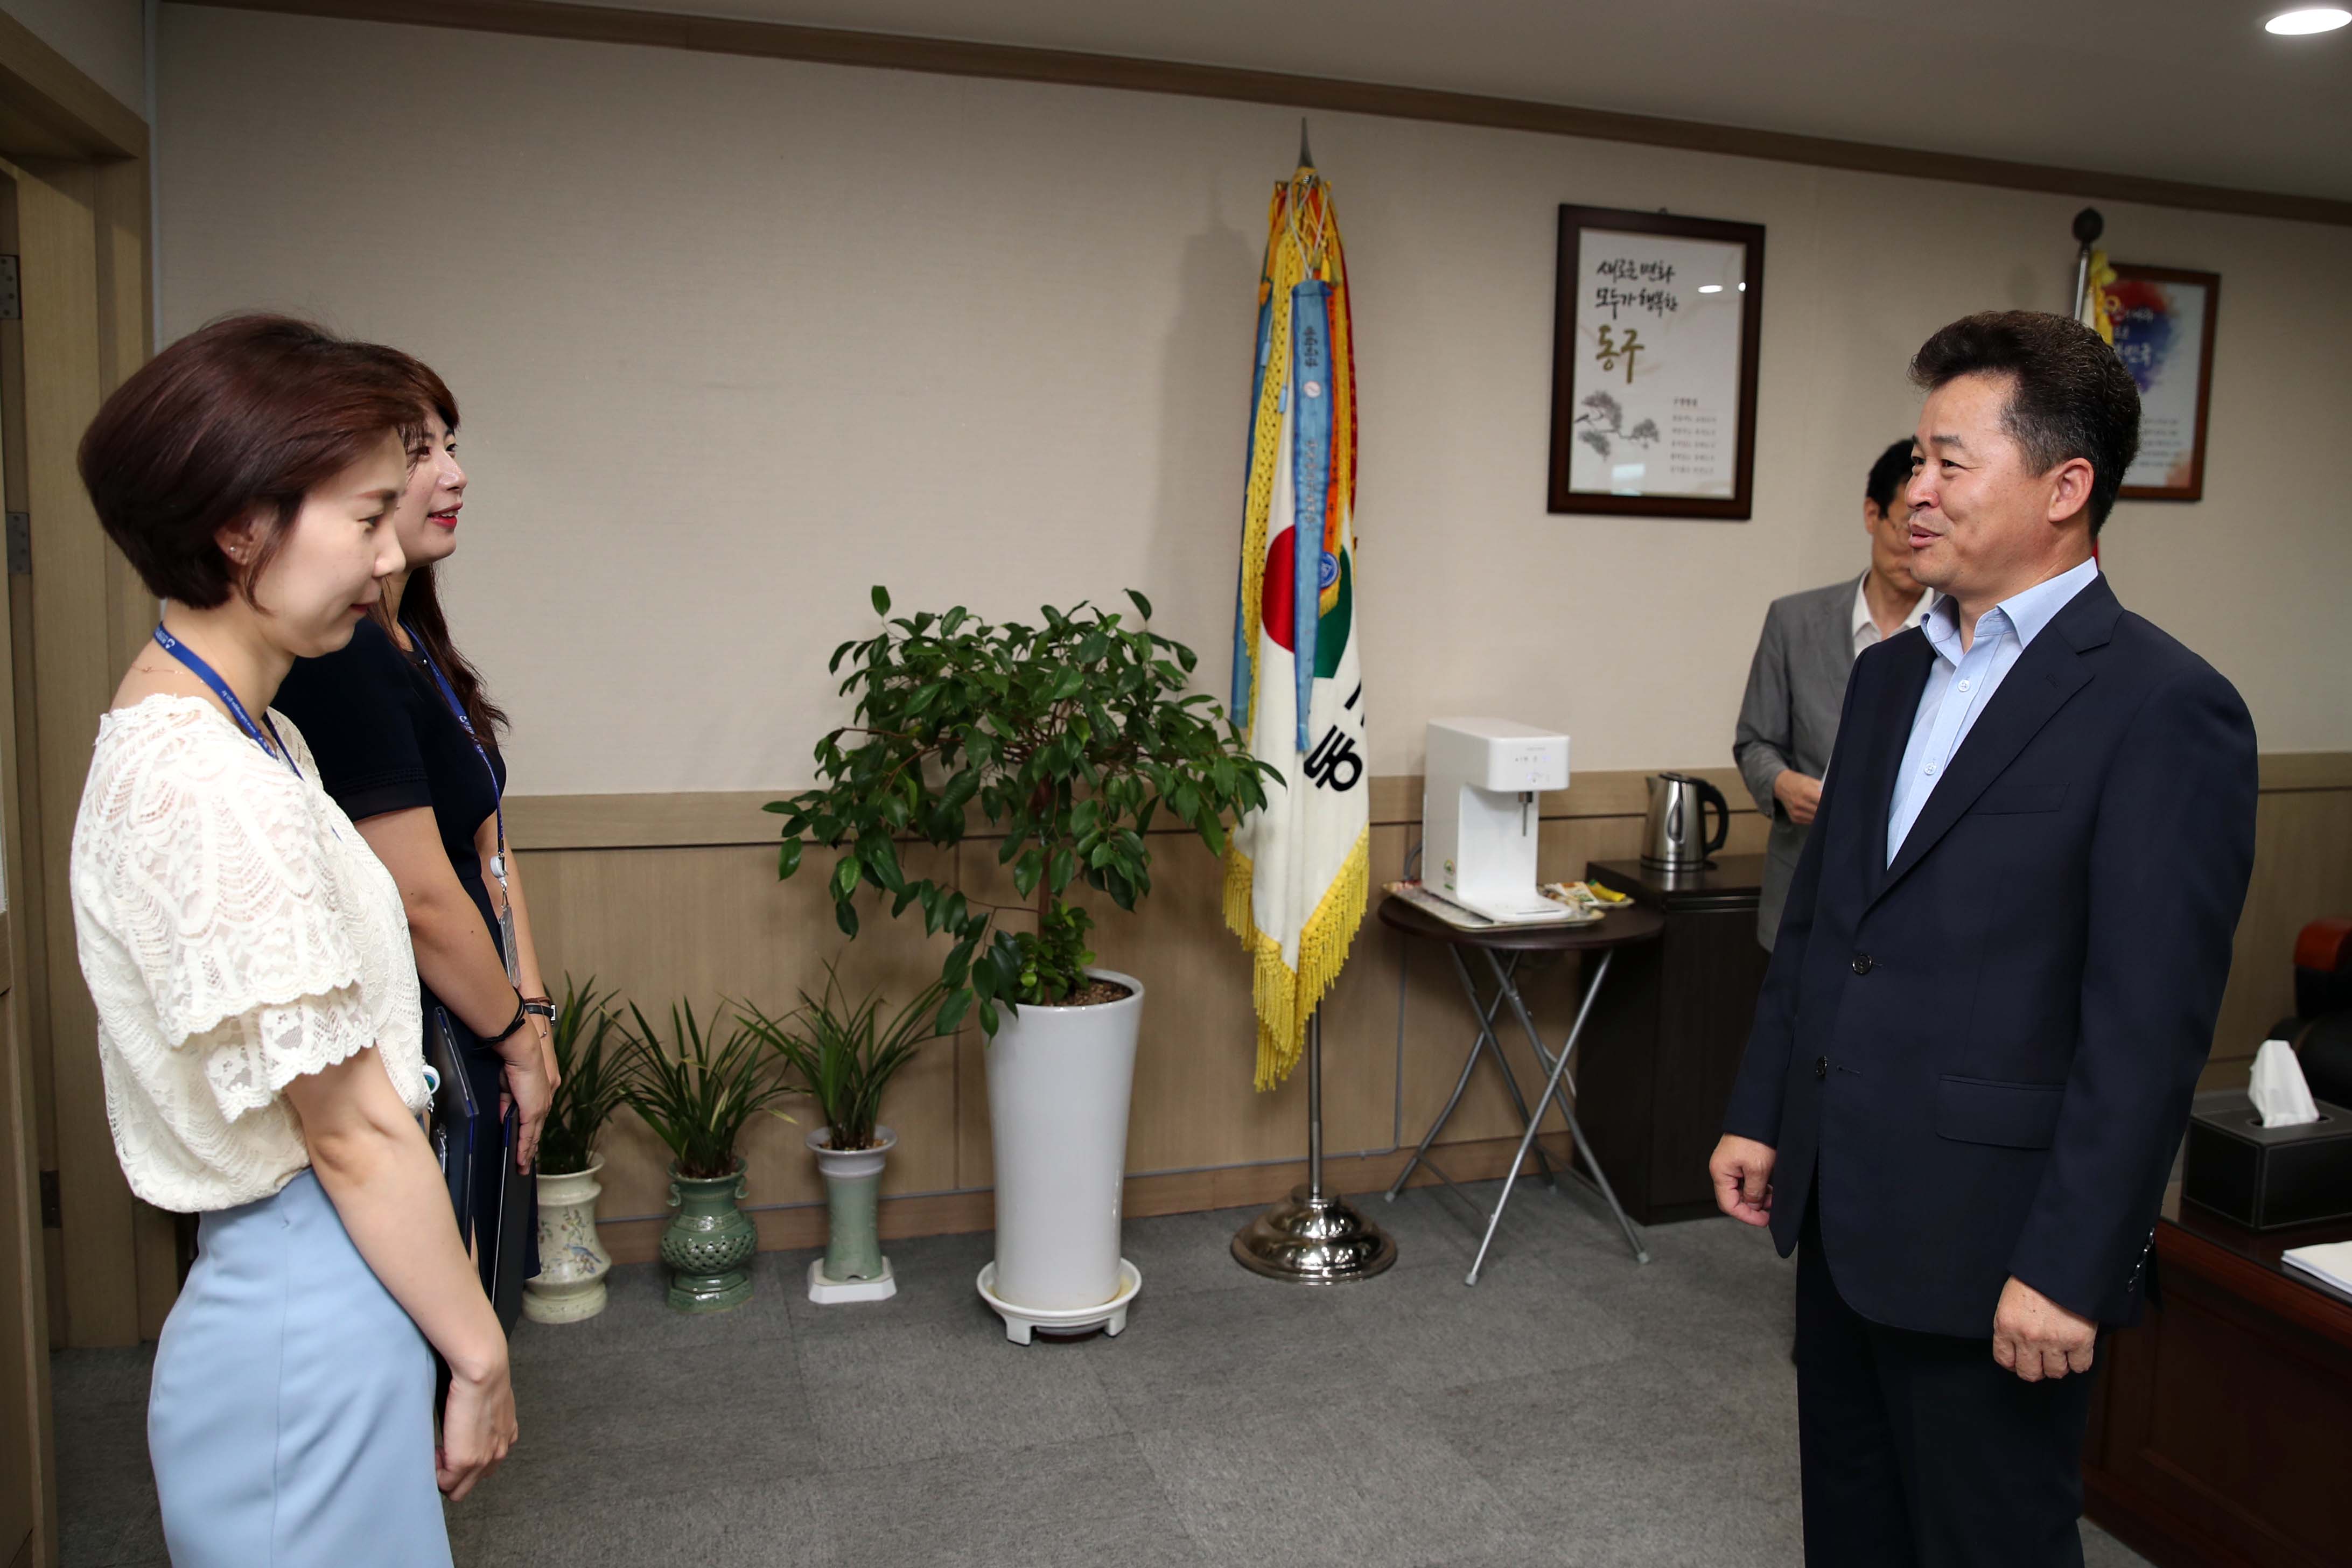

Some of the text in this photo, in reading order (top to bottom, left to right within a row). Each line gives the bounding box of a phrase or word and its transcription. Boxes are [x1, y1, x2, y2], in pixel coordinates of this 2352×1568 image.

[1597, 258, 1676, 284] 새로운 변화
[1595, 287, 1678, 320] 모두가 행복한
[1596, 324, 1645, 384] 동구
